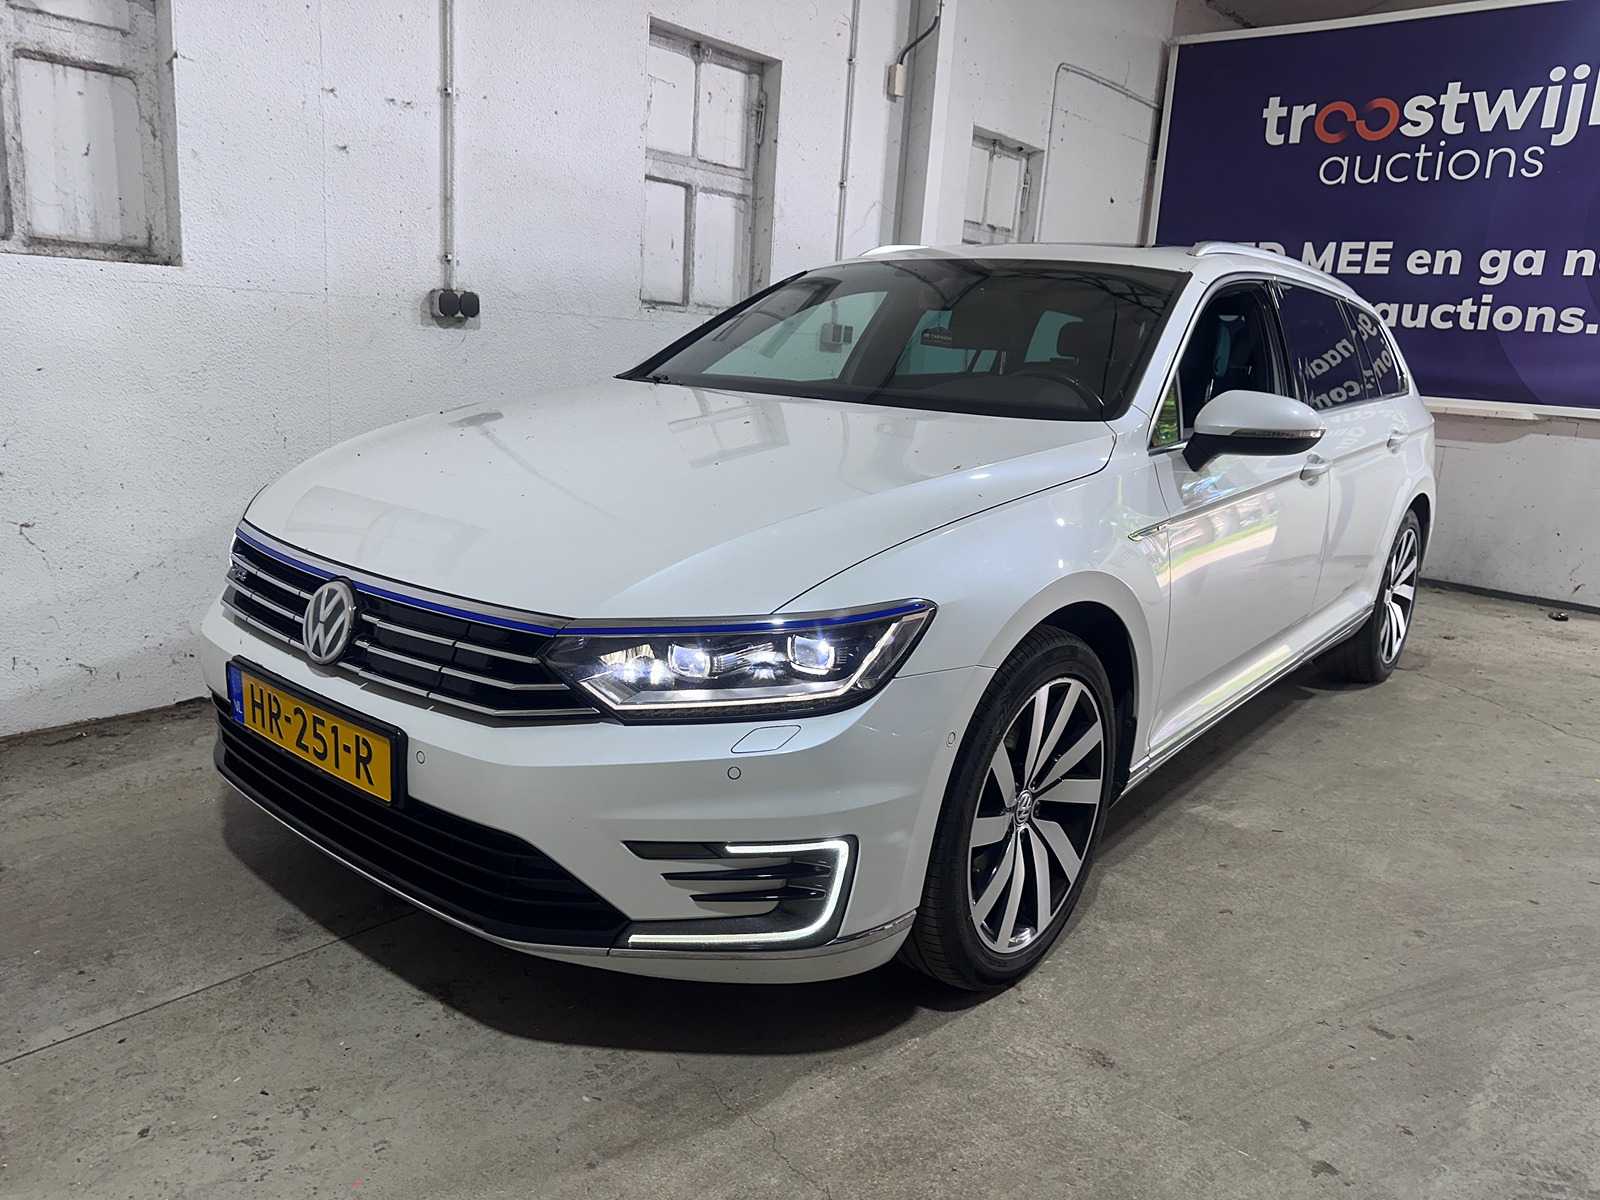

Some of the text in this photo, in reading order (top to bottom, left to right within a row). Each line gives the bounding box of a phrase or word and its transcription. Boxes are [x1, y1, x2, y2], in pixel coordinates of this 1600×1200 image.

[1319, 141, 1545, 185] auctions
[1302, 242, 1394, 275] MEE
[1406, 248, 1462, 276] en
[1479, 249, 1546, 285] ga
[1563, 249, 1600, 276] n
[250, 682, 374, 786] HR-251-R
